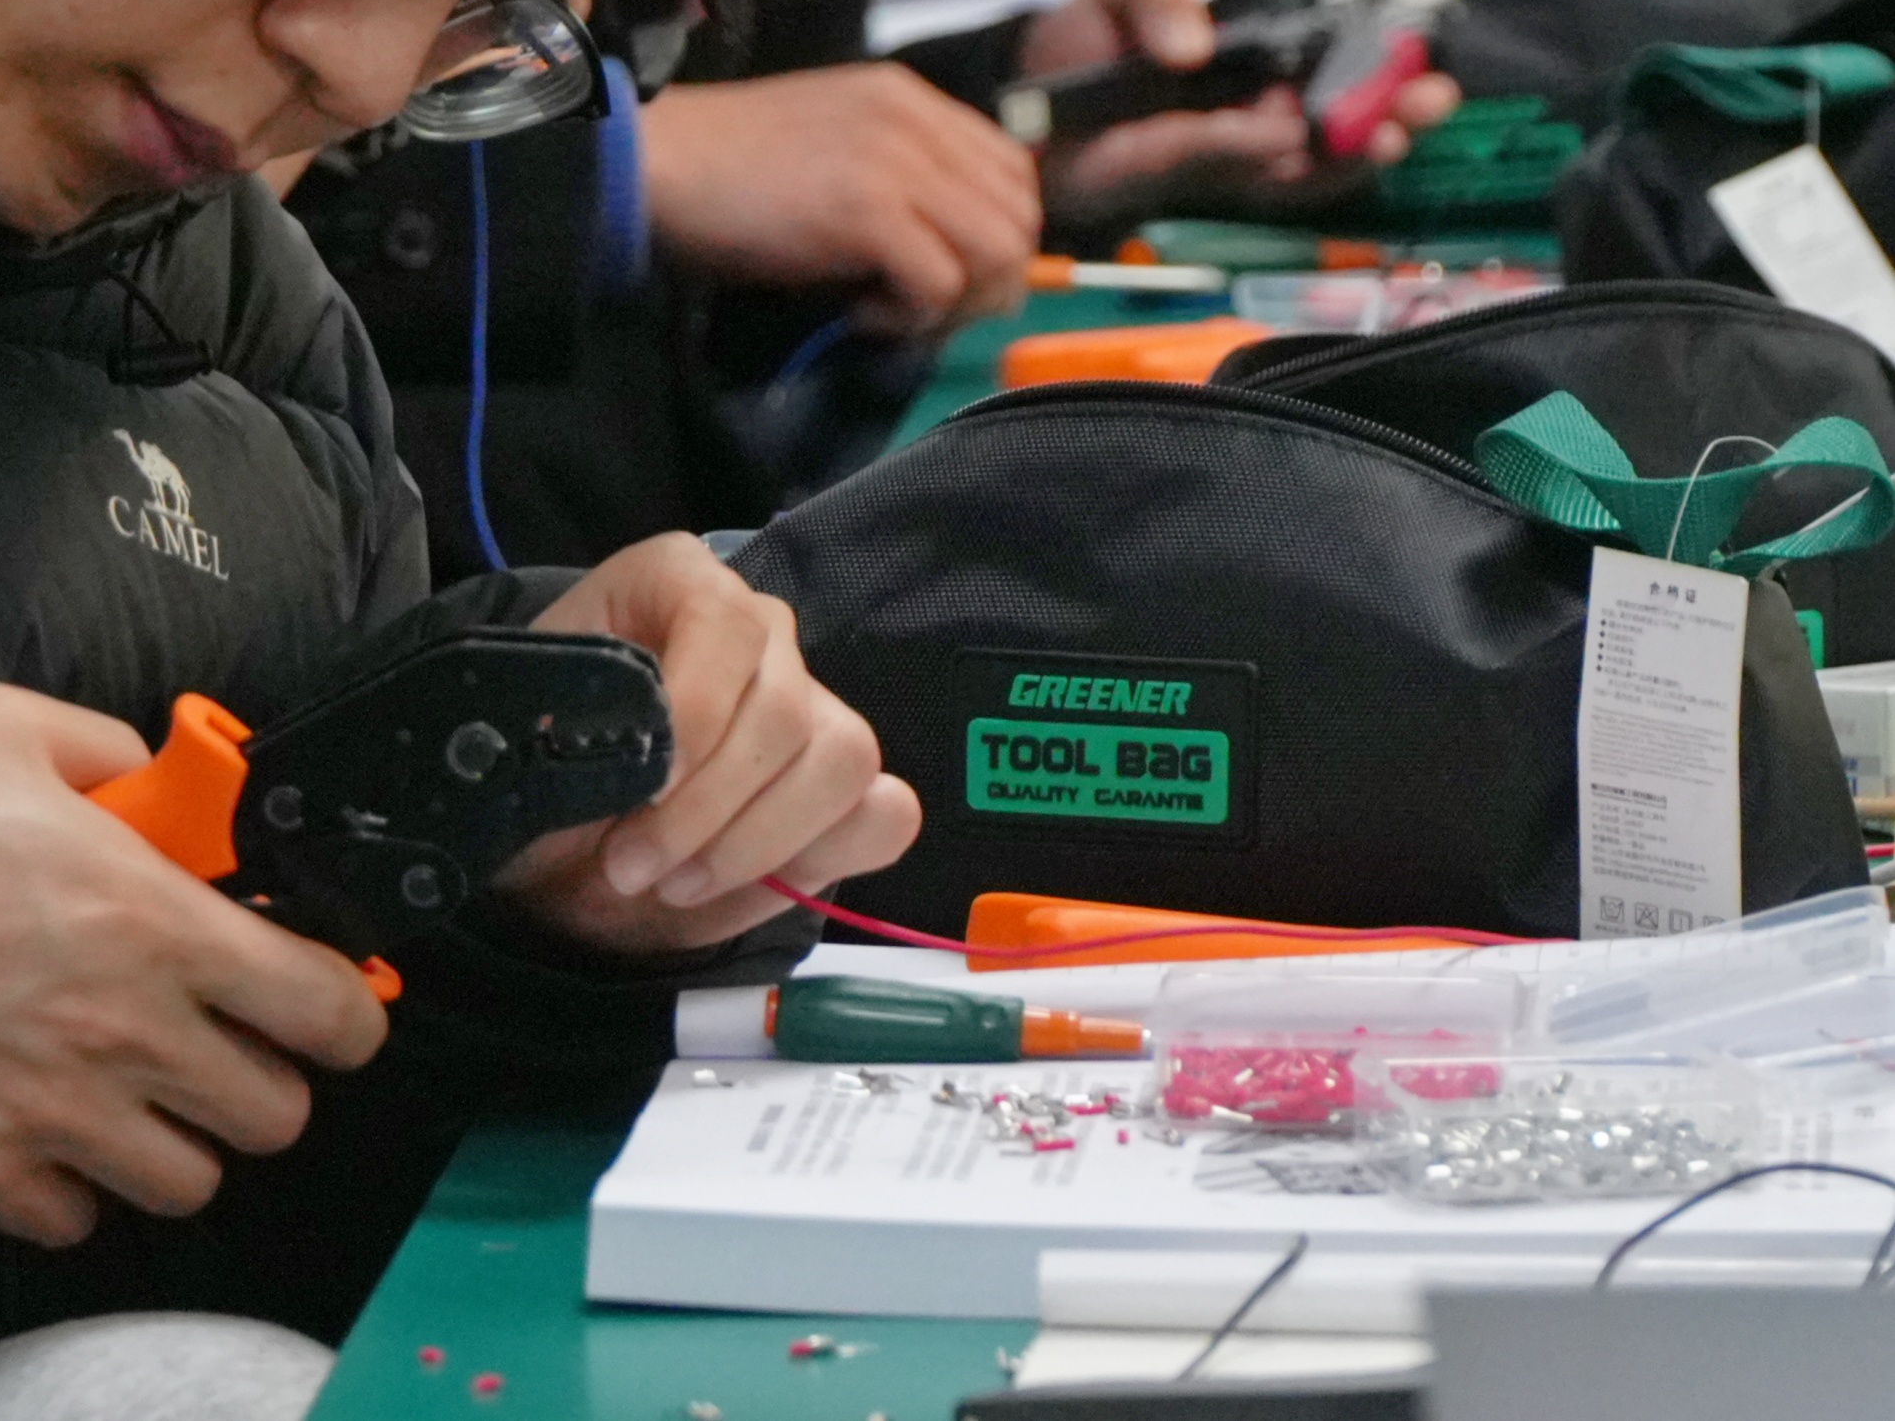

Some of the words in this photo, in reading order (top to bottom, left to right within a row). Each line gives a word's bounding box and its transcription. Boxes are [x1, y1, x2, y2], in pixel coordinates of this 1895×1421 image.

[108, 495, 229, 580] CAMEL
[1009, 673, 1192, 715] GREENER
[981, 732, 1100, 777] TOOL
[987, 782, 1079, 805] QUALITY
